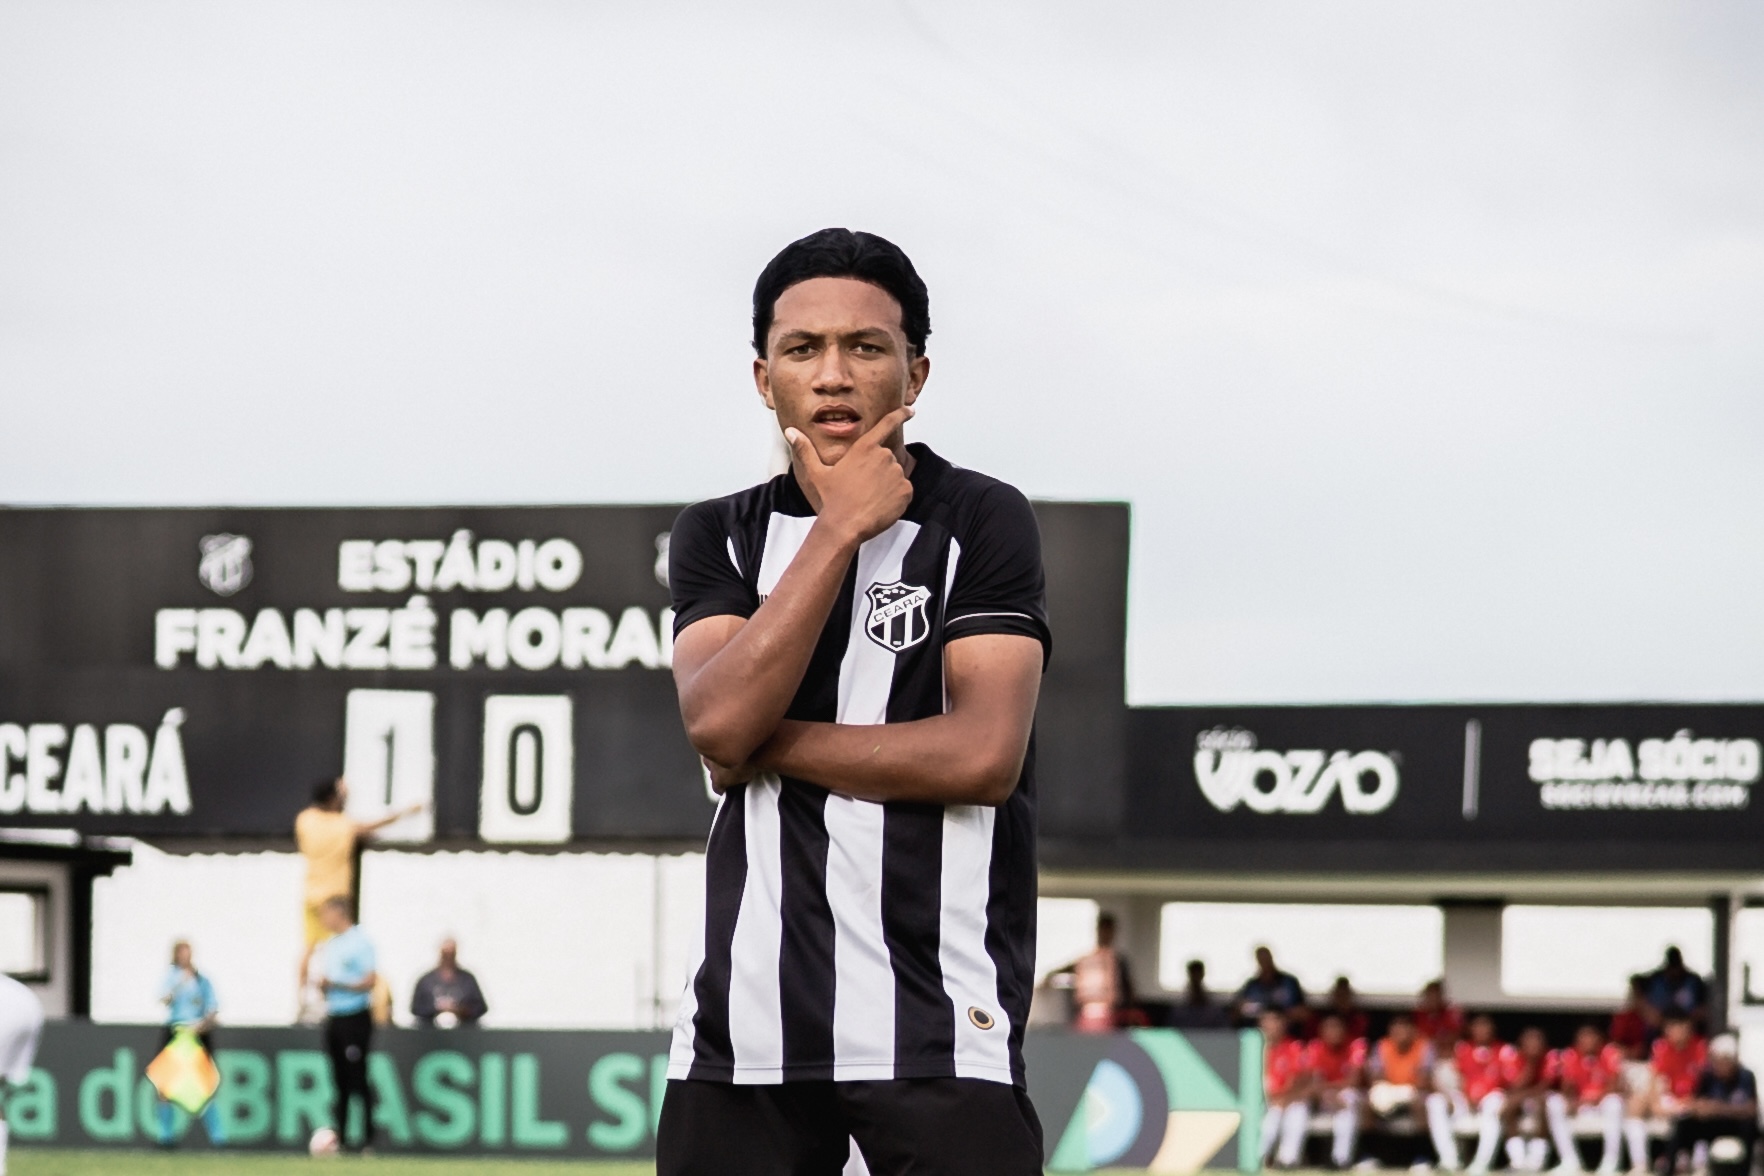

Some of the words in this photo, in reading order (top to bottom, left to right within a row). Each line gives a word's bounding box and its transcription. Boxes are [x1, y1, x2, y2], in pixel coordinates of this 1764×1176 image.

[338, 529, 582, 592] ESTÁDIO
[155, 594, 437, 671] FRANZÉ
[0, 707, 192, 814] CEARÁ
[381, 723, 395, 806] 1
[508, 722, 544, 816] 0
[219, 1049, 569, 1149] BRASIL
